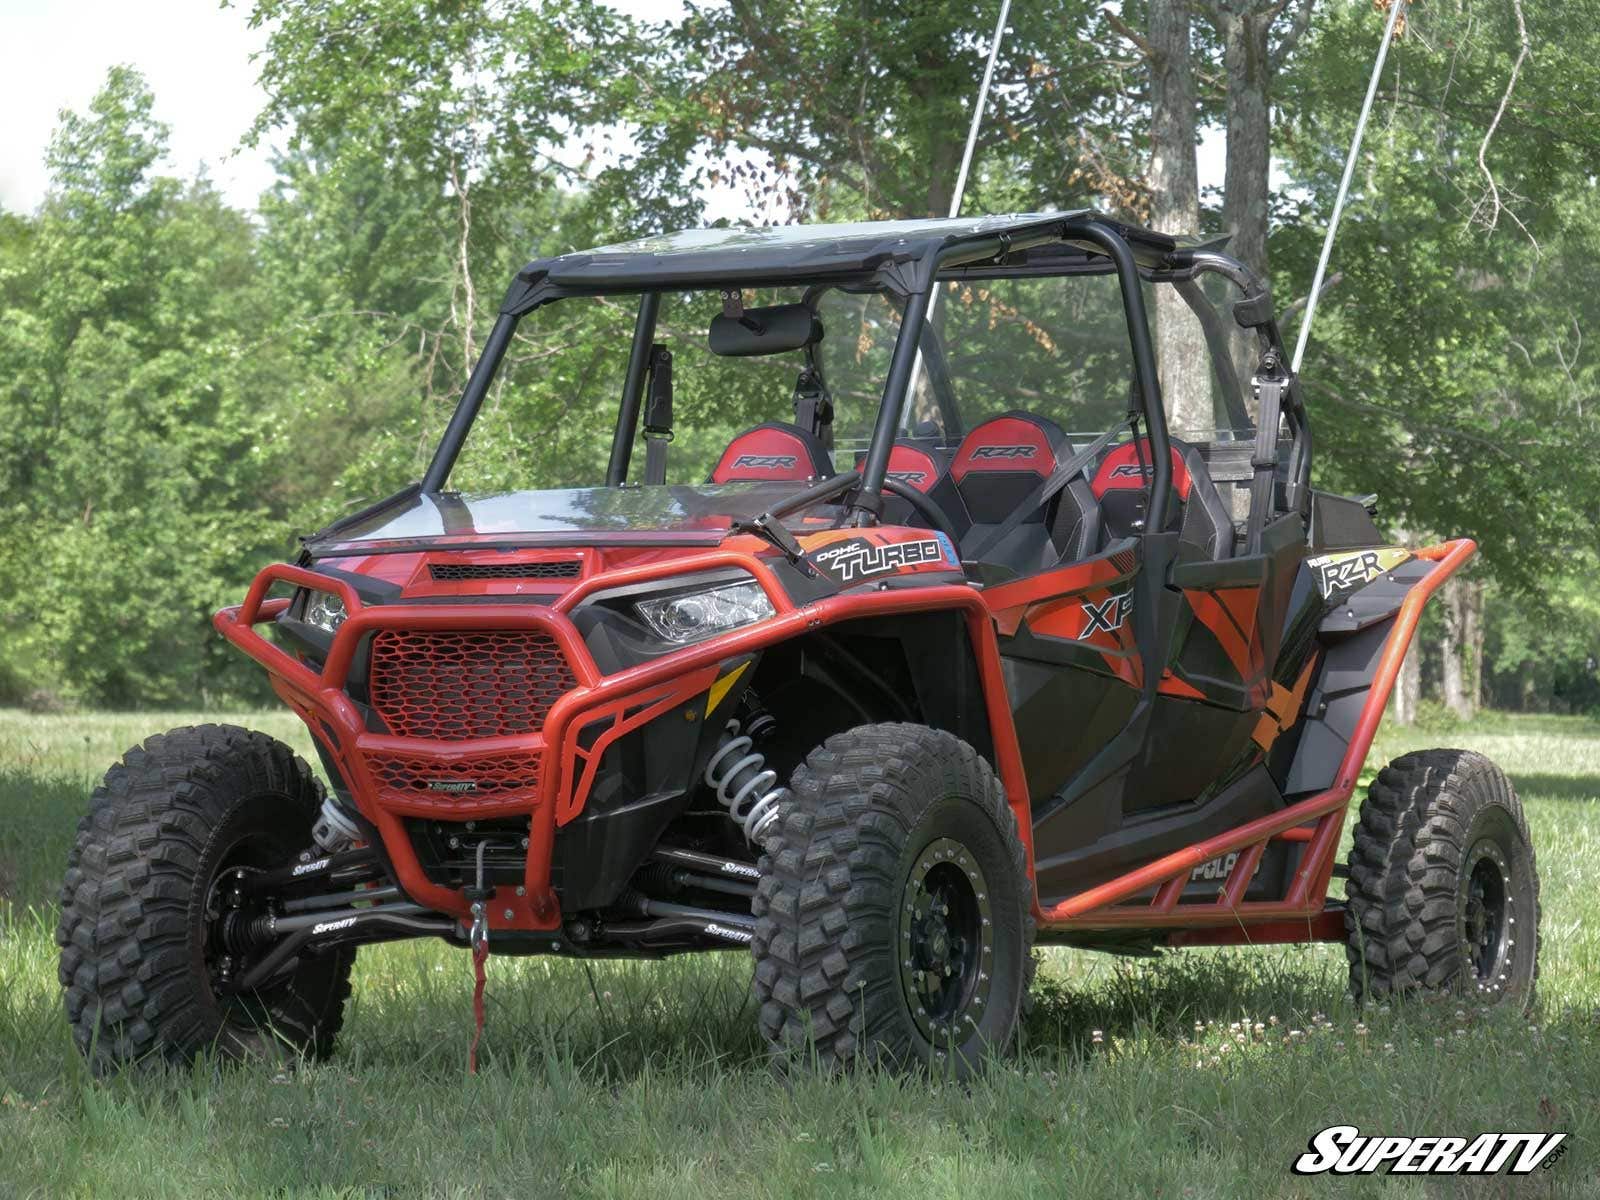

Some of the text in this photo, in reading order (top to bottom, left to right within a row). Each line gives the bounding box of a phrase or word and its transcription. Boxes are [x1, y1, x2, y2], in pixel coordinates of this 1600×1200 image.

[732, 455, 797, 469] RZR
[969, 446, 1038, 461] RZR
[886, 471, 928, 484] ZR
[1110, 464, 1154, 479] RZ
[816, 542, 861, 563] DOHC
[831, 539, 942, 581] TURBO
[1321, 551, 1386, 599] RZR
[1076, 587, 1135, 641] XP
[1192, 852, 1260, 880] POLA
